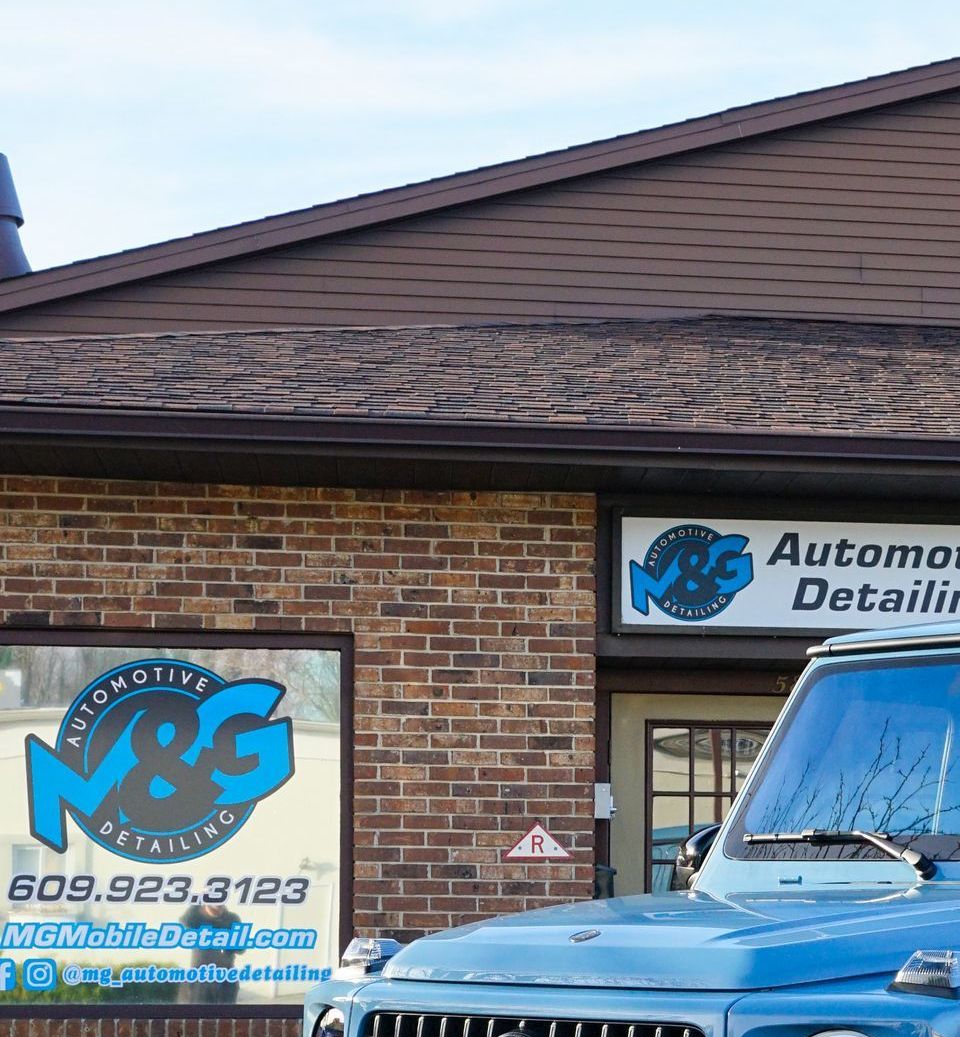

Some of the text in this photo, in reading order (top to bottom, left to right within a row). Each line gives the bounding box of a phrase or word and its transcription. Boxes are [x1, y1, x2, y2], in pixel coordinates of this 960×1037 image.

[648, 528, 714, 567] AUTOMOTIVE
[664, 595, 727, 617] DETAILING
[66, 667, 209, 748] AUTOMOTIVE
[99, 809, 235, 853] DETAILING
[532, 834, 545, 854] R
[7, 875, 310, 904] 609.923.3123
[2, 923, 317, 949] MGMobileDetail.com
[63, 963, 332, 987] @mg_automotivedetailing
